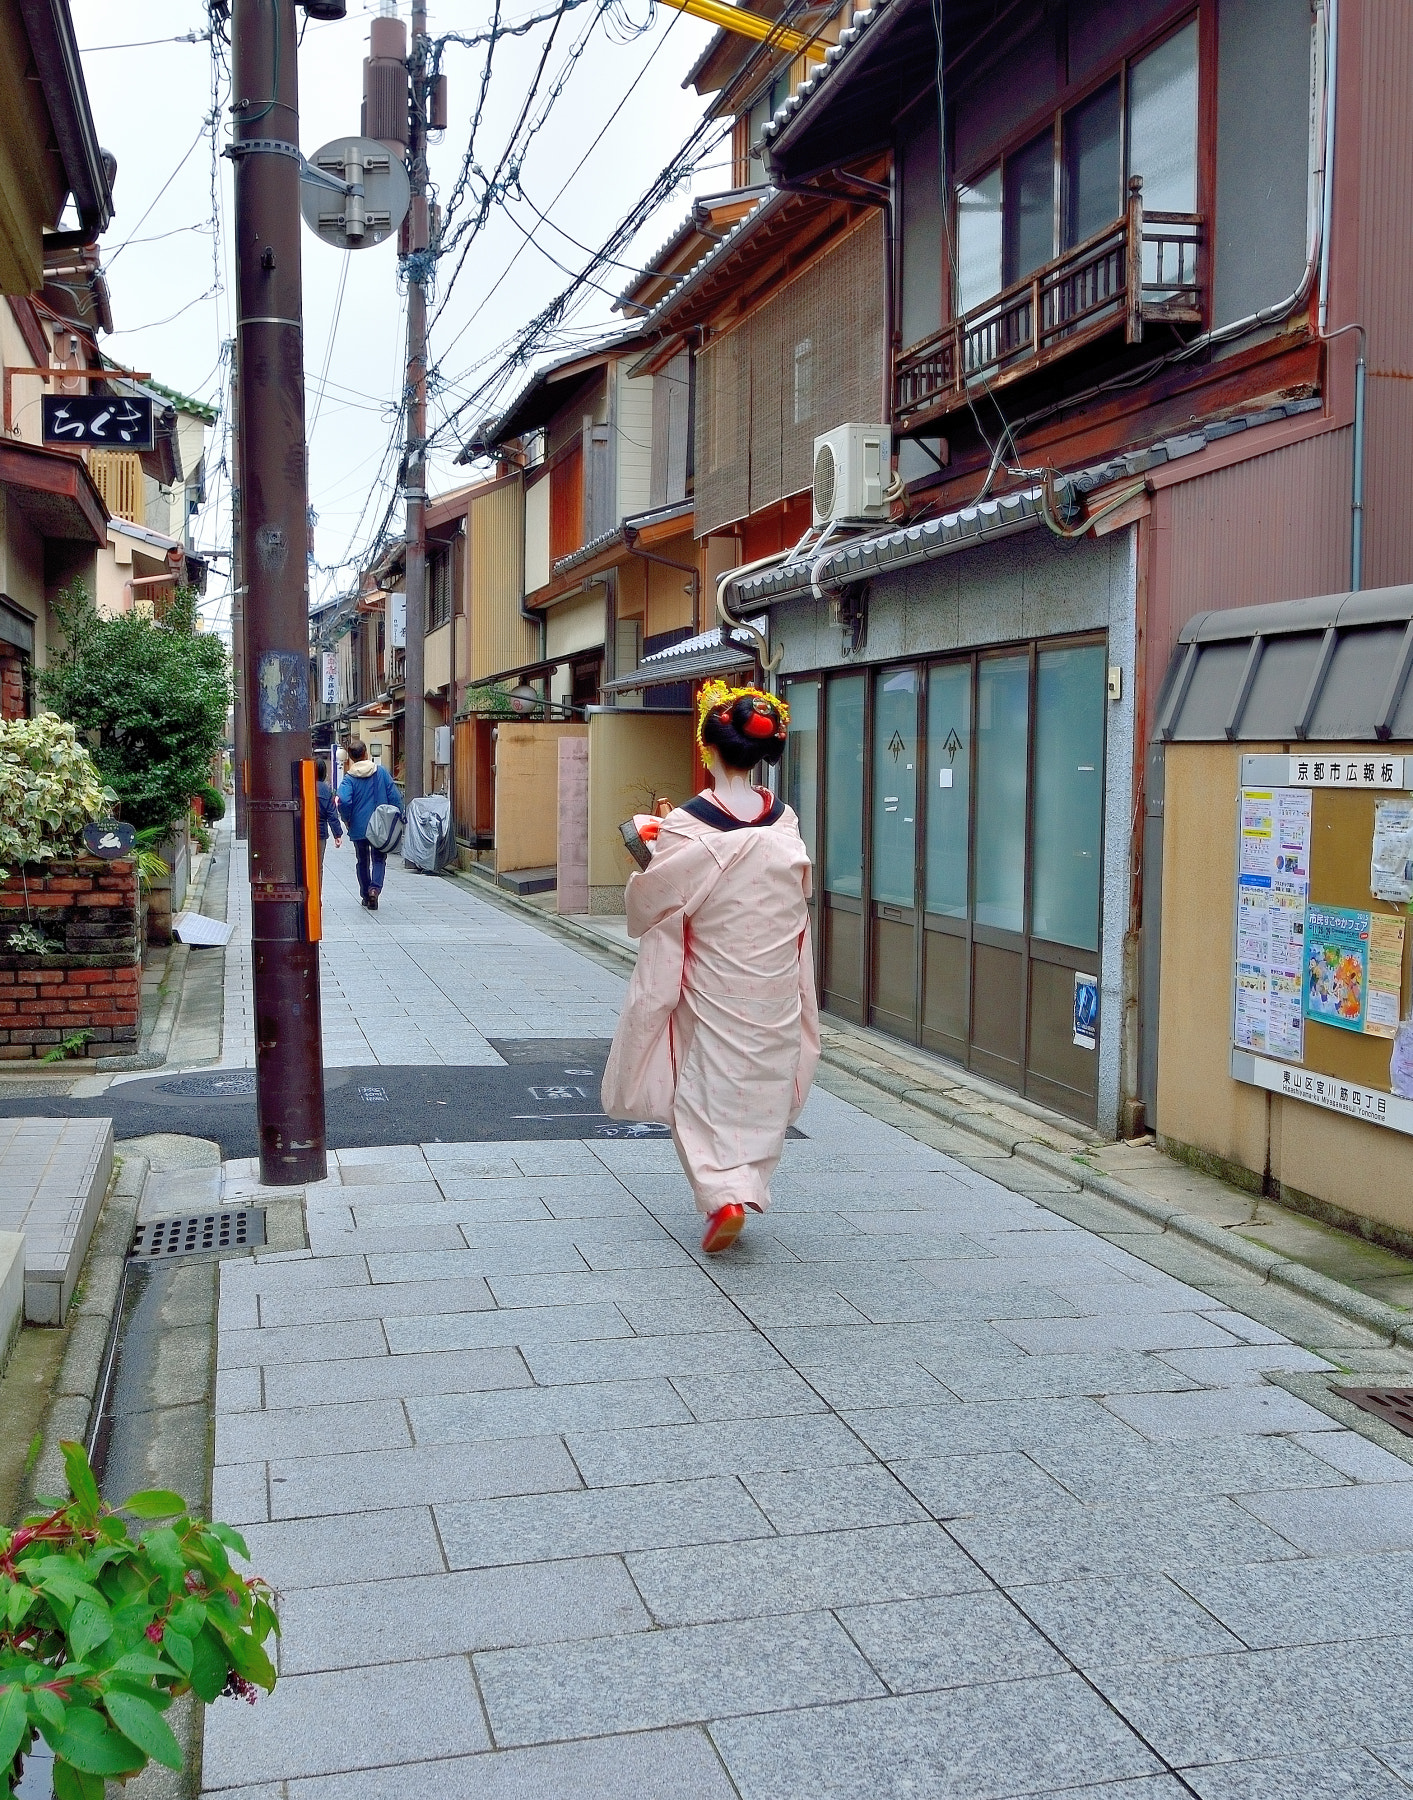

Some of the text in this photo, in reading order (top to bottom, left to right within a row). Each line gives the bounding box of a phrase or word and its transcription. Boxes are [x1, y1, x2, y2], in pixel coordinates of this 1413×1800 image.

[1297, 761, 1393, 782] 京都市広報板
[1309, 913, 1368, 931] 市民すこやかフェア
[1282, 1084, 1320, 1101] Higashiyama-ku
[1283, 1071, 1386, 1113] 東山区宮川筋四丁目
